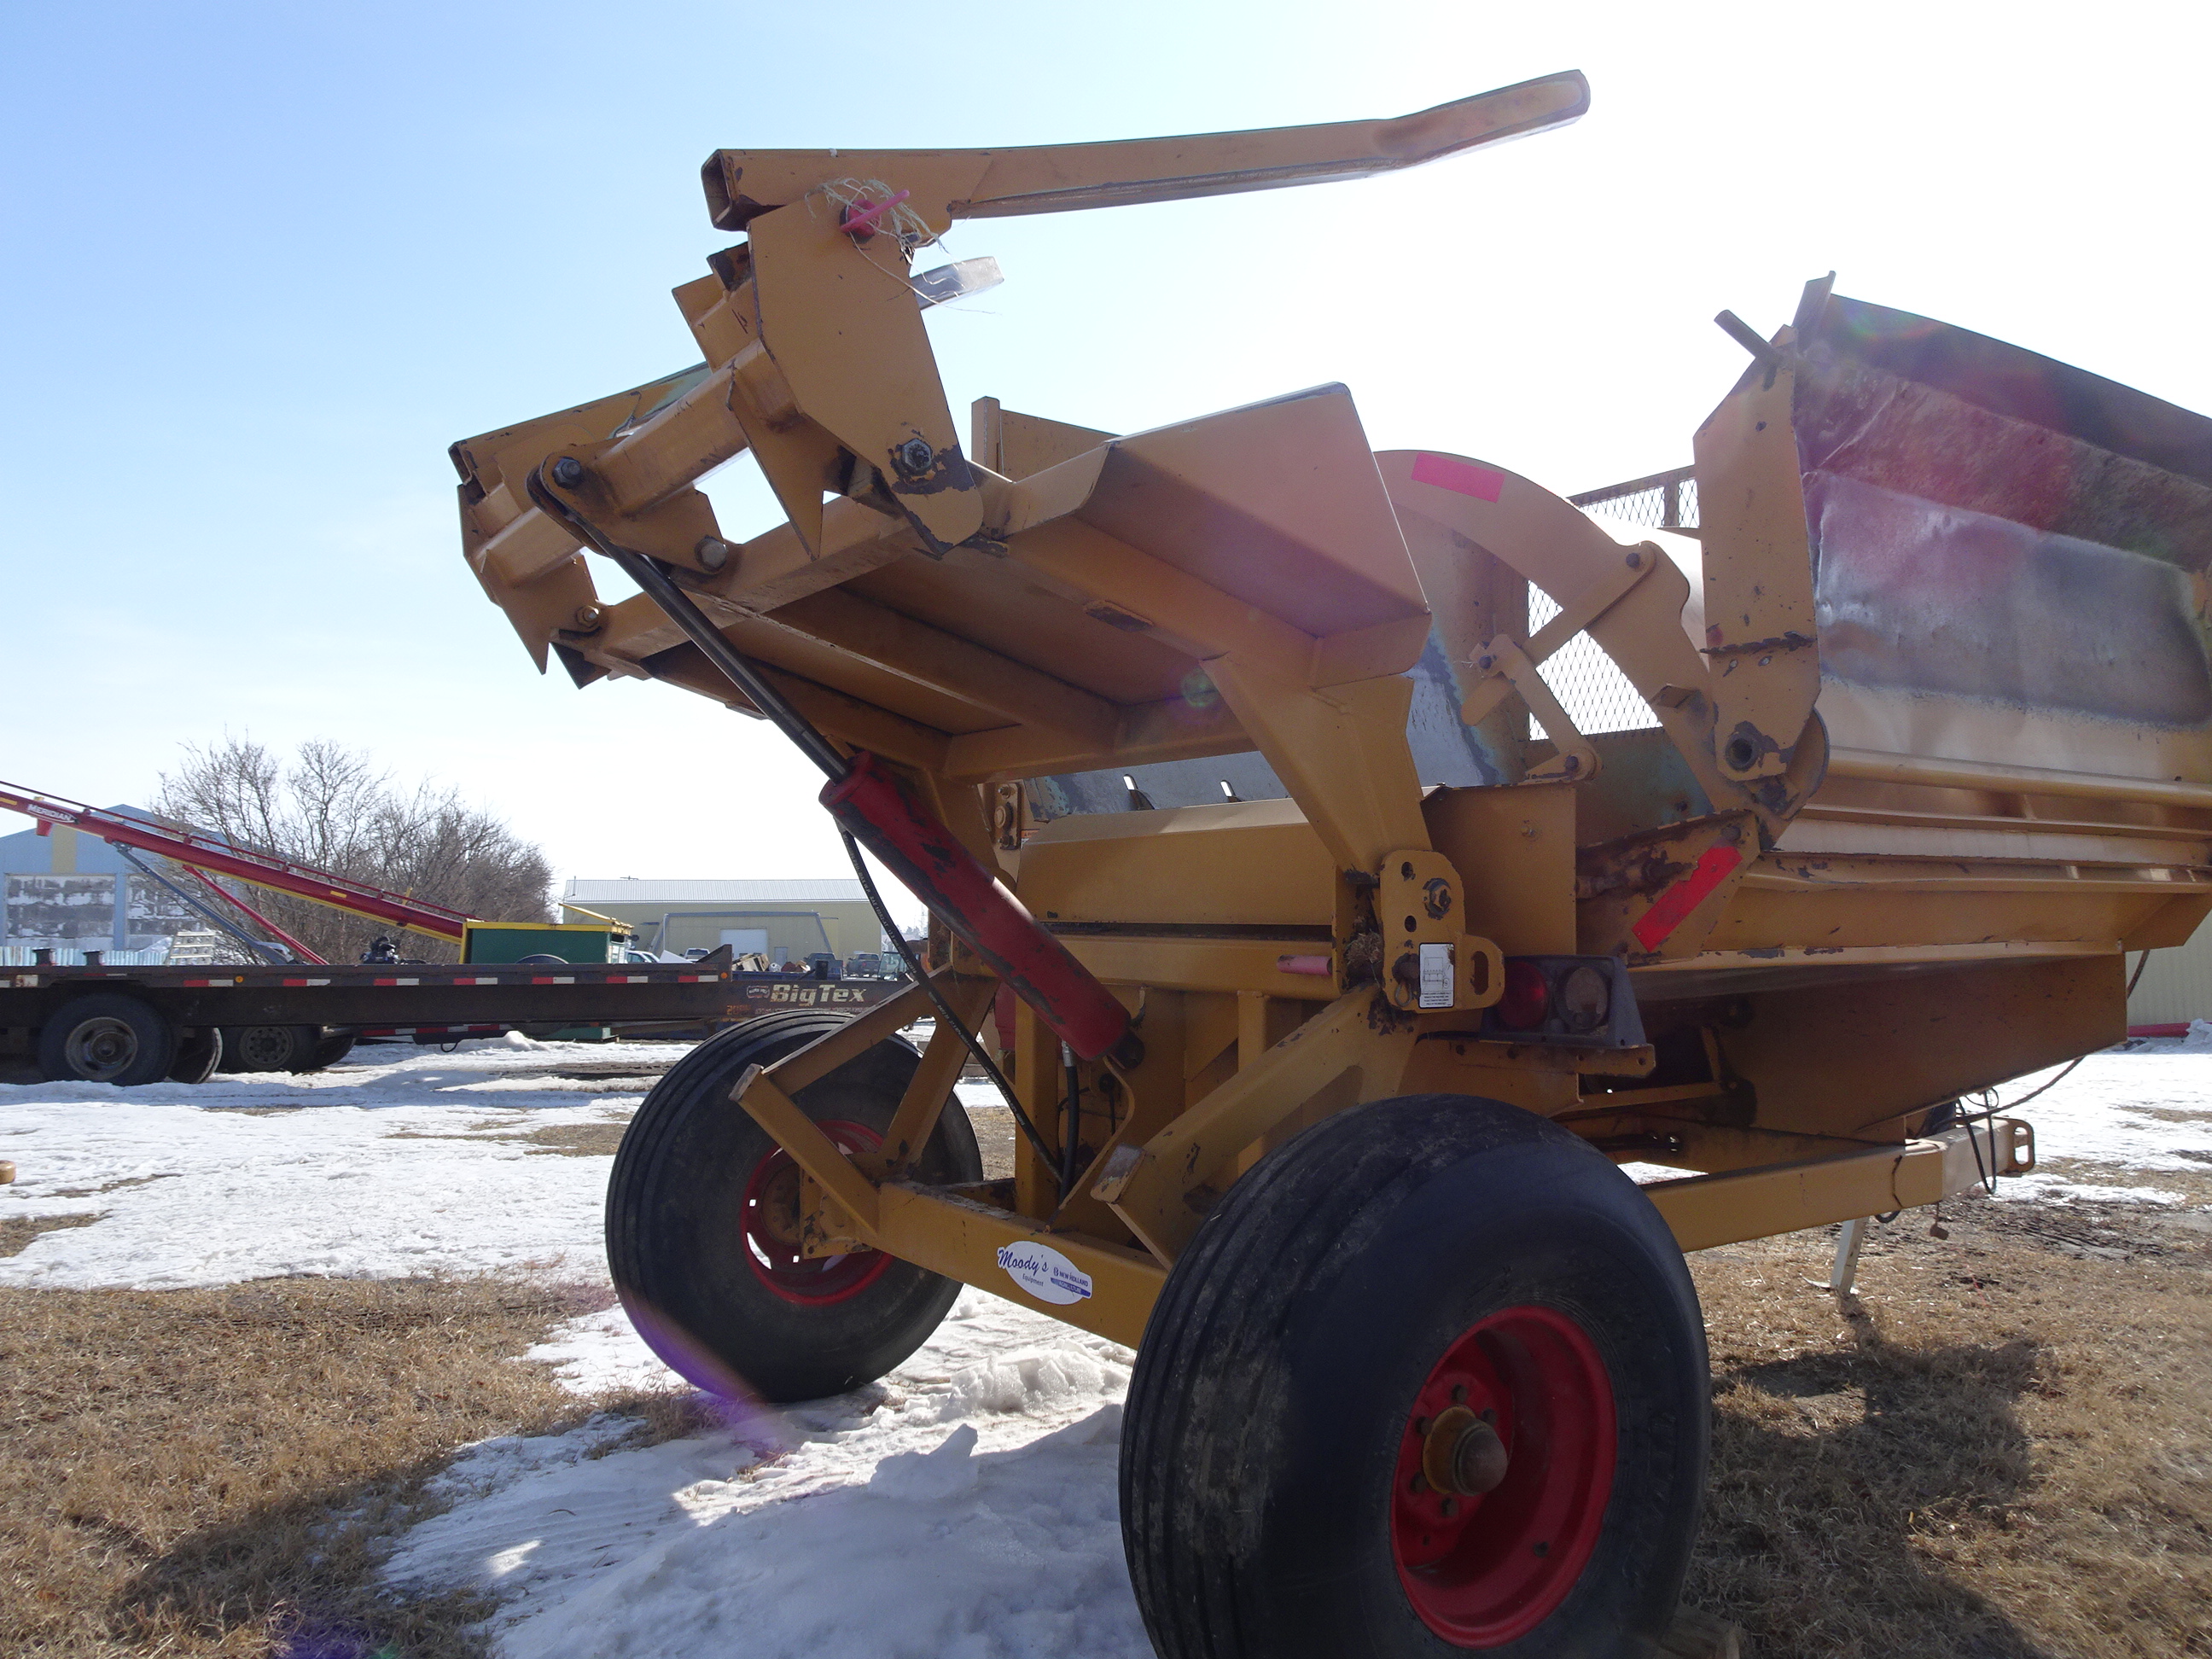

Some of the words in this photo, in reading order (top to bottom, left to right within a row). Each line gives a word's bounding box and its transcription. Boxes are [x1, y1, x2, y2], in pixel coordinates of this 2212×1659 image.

[27, 804, 72, 821] MERIDIAN
[998, 1249, 1049, 1276] Moody's
[1022, 1273, 1044, 1287] Equipment
[1059, 1271, 1069, 1280] NEW
[1069, 1272, 1089, 1287] HOLLAND
